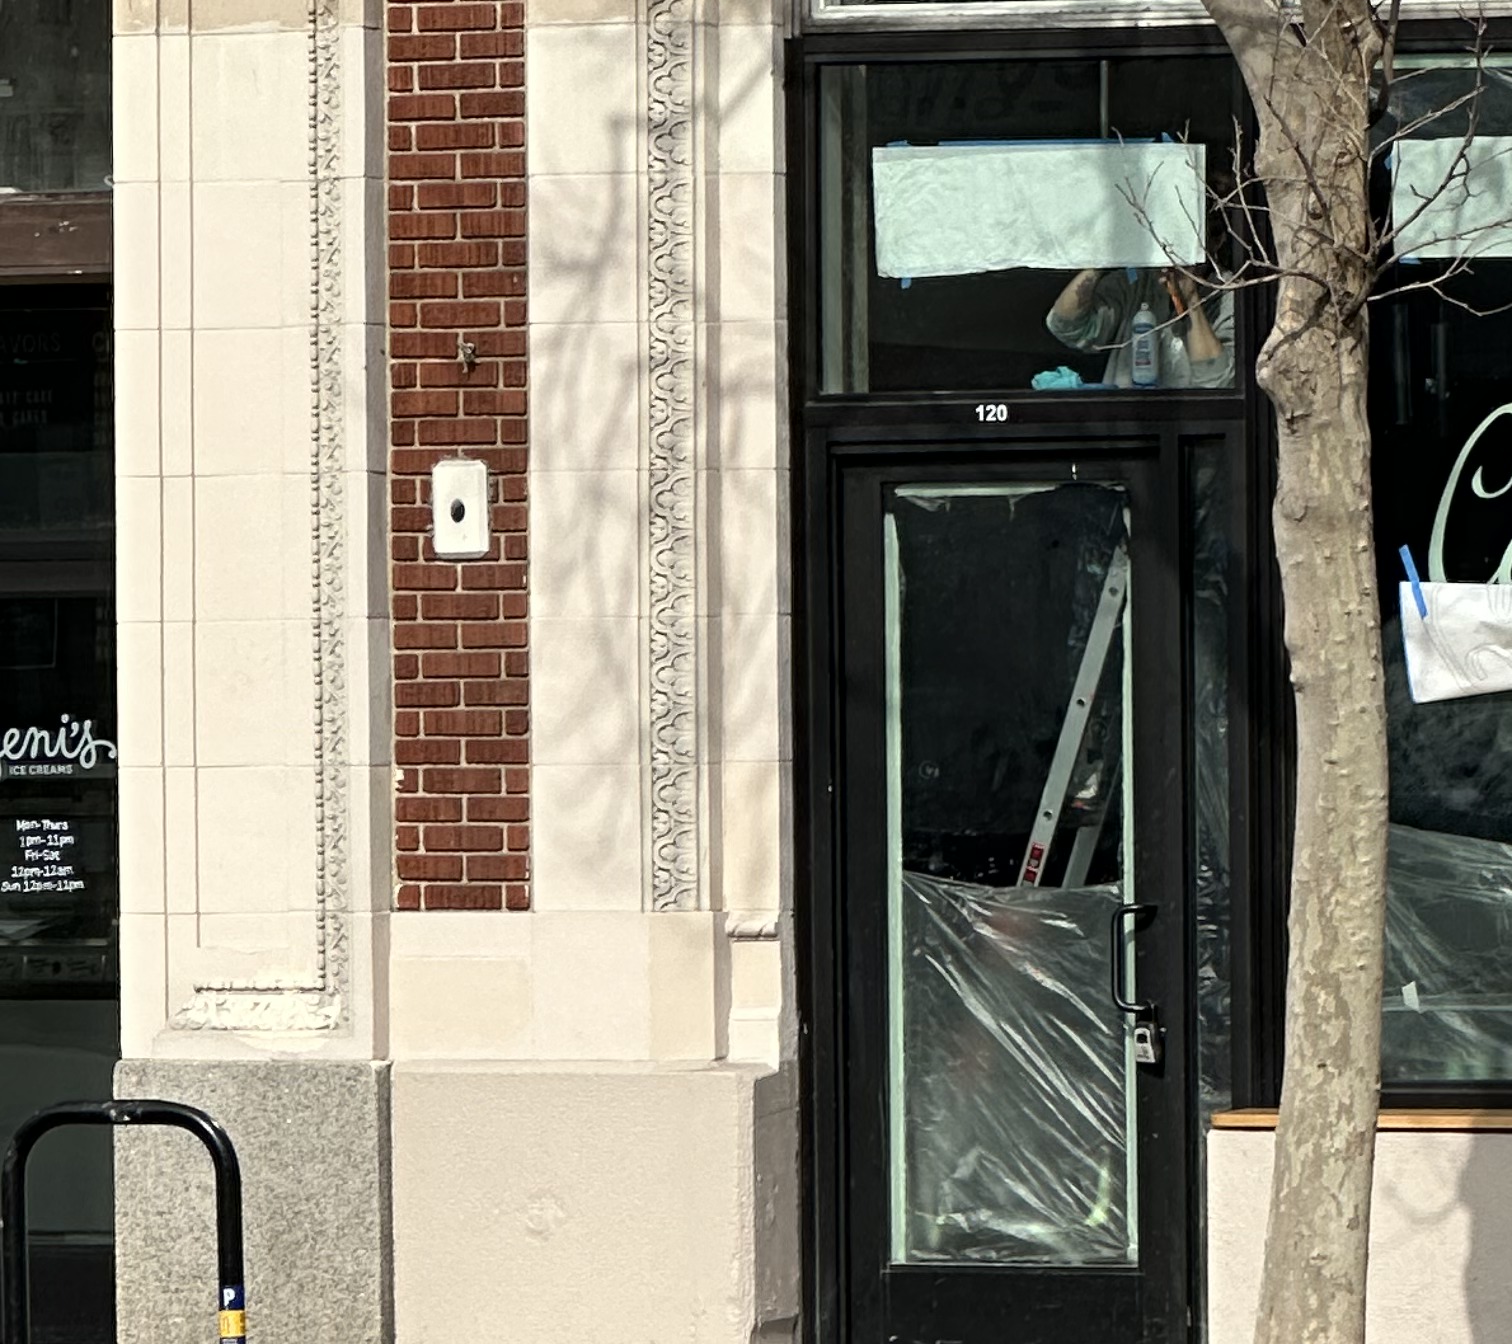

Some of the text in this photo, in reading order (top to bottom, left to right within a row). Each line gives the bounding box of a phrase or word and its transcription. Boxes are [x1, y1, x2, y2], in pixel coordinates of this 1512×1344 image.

[975, 404, 1008, 422] 120
[0, 713, 117, 769] eni's
[9, 764, 73, 776] ICE CREAMS
[0, 880, 21, 893] Sun
